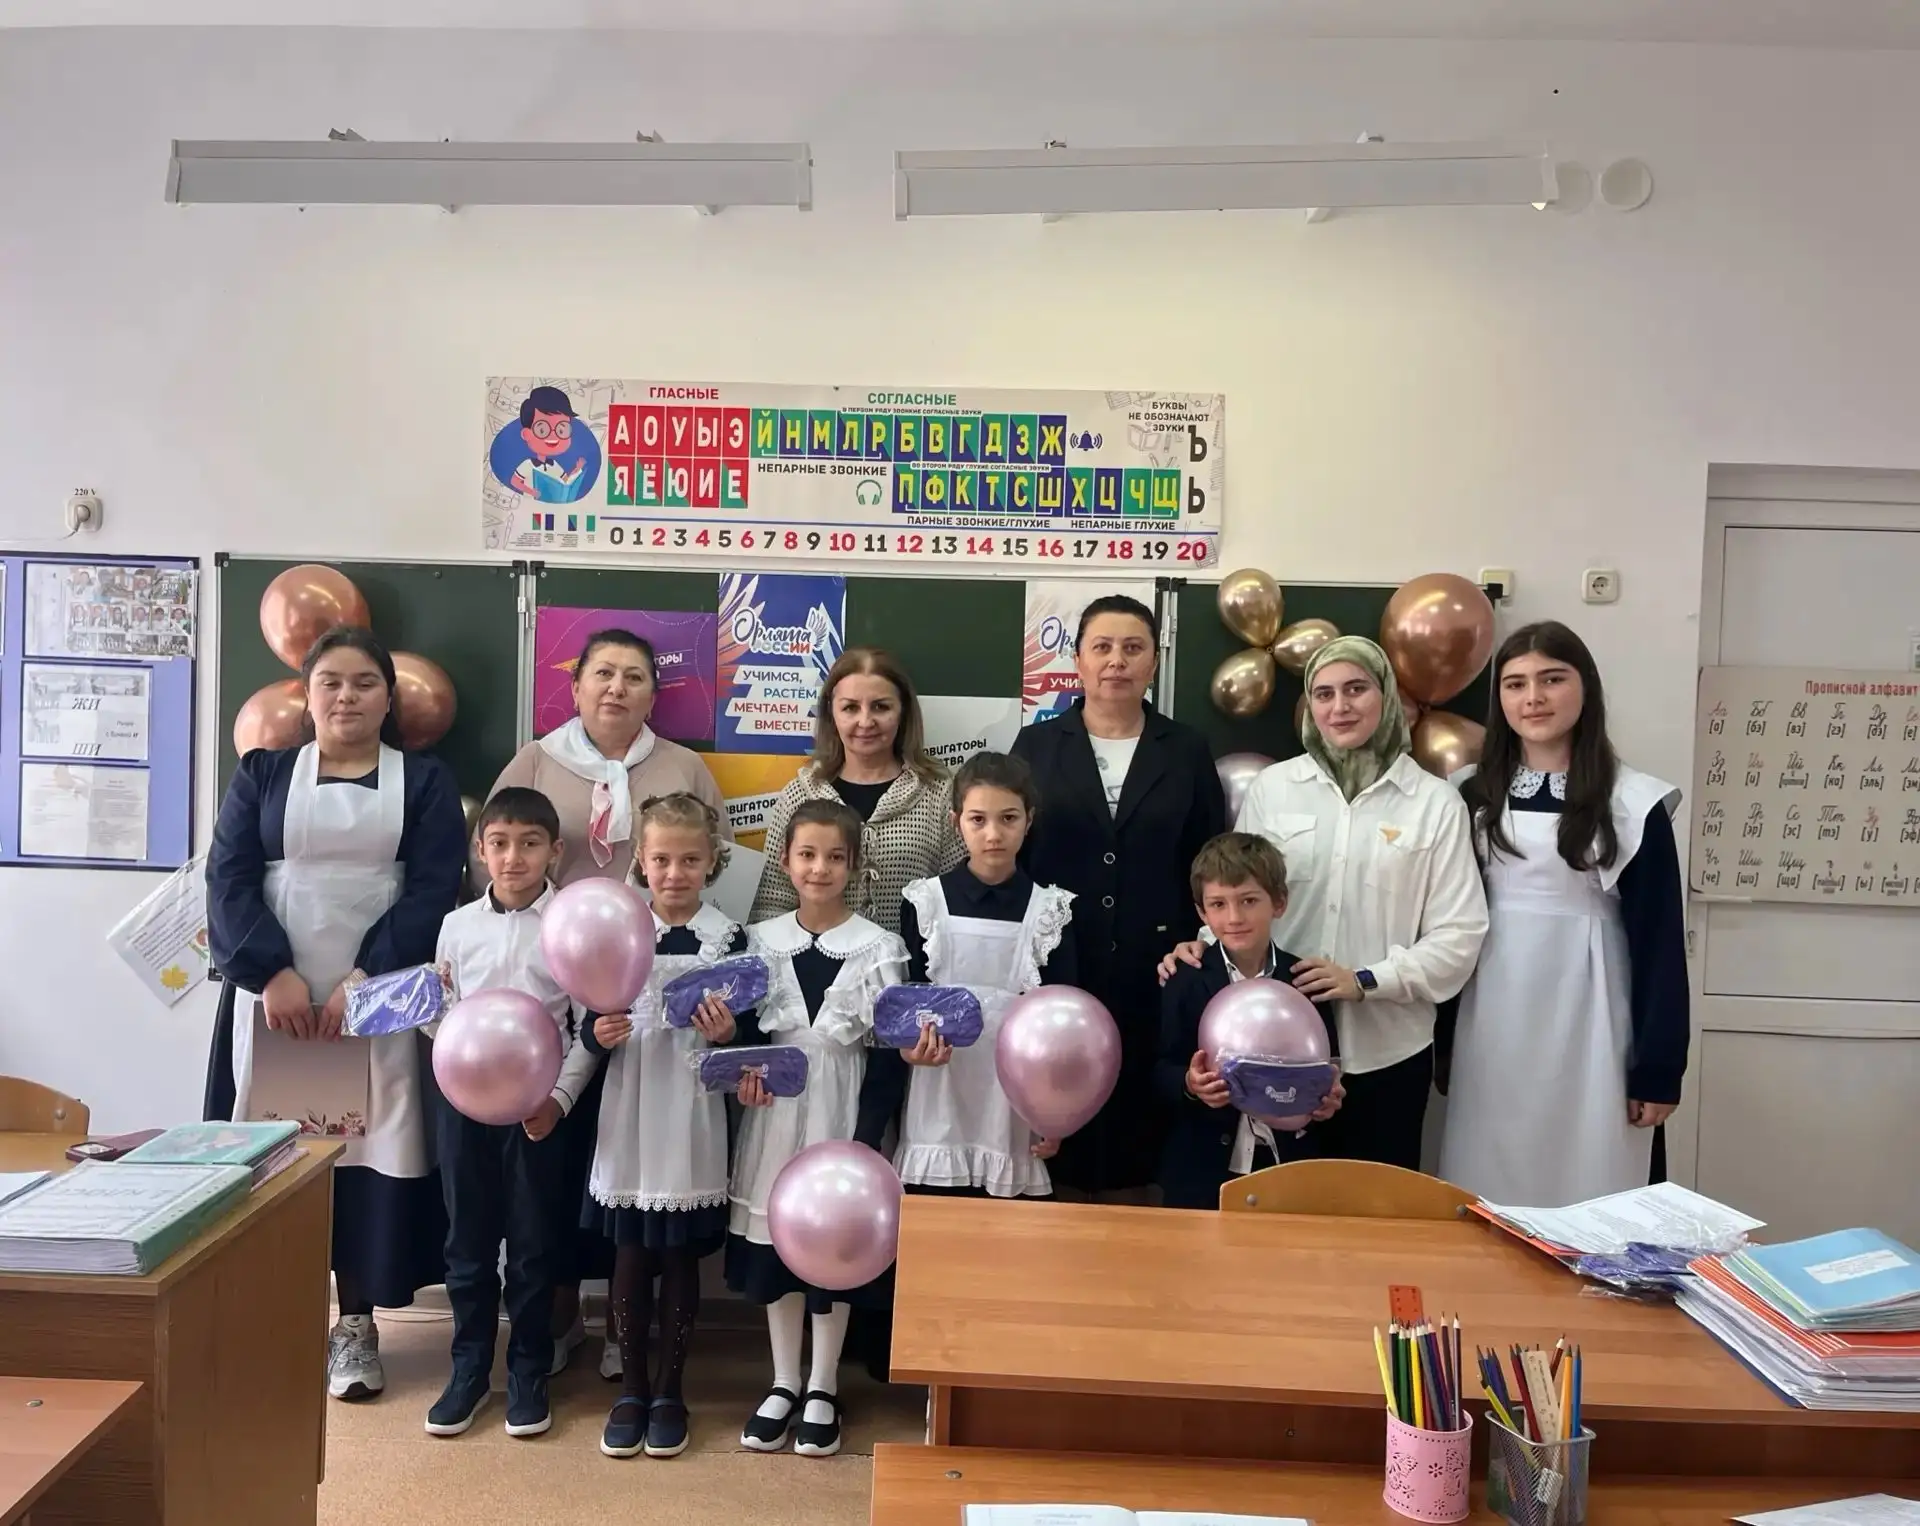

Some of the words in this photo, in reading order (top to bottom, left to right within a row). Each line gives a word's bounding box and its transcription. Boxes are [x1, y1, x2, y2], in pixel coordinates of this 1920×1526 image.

[649, 387, 719, 400] ГЛАСНЫЕ
[867, 392, 957, 405] СОГЛАСНЫЕ
[1152, 402, 1187, 410] БУКВЫ
[1128, 412, 1141, 420] НЕ
[1144, 412, 1209, 422] ОБОЗНАЧАЮТ
[614, 415, 630, 445] А
[644, 415, 658, 446] О
[671, 416, 687, 446] У
[697, 417, 718, 447] Ы
[729, 418, 743, 448] Э
[1153, 424, 1185, 432] ЗВУКИ
[1188, 425, 1207, 462] Ъ
[758, 463, 826, 474] НЕПАРНЫЕ
[830, 465, 887, 476] ЗВОНКИЕ
[614, 466, 629, 496] Я
[642, 464, 656, 499] Ё
[667, 467, 688, 498] Ю
[699, 468, 713, 499] И
[728, 469, 741, 499] Е
[74, 488, 88, 496] 220
[1188, 476, 1205, 514] Ь
[907, 516, 952, 526] ПАРНЫЕ
[956, 517, 1050, 528] ЗВОНКИЕ/ГЛУХИЕ
[1071, 520, 1131, 530] НЕПАРНЫЕ
[1134, 520, 1175, 530] ГЛУХИЕ
[610, 527, 624, 545] 0
[633, 528, 643, 545] 1
[652, 528, 666, 546] 2
[673, 529, 687, 546] 3
[695, 529, 710, 547] 4
[718, 530, 732, 547] 5
[741, 531, 754, 548] 6
[764, 531, 776, 549] 7
[784, 531, 798, 549] 8
[807, 532, 820, 550] 9
[830, 533, 855, 551] 10
[864, 534, 887, 552] 11
[897, 535, 923, 553] 12
[932, 536, 957, 554] 13
[967, 537, 993, 555] 14
[1002, 538, 1028, 556] 15
[1038, 539, 1064, 557] 16
[1073, 540, 1098, 558] 17
[1107, 540, 1133, 559] 18
[1142, 541, 1169, 560] 19
[1177, 542, 1207, 560] 20
[735, 608, 811, 646] Орлята
[743, 670, 802, 683] УЧИМСЯ,
[1805, 680, 1866, 696] Прописной
[1870, 682, 1918, 698] алфавит
[72, 697, 101, 710] ЖИ
[734, 703, 798, 714] МЕЧТАЕМ
[754, 720, 811, 731] ВМЕСТЕ!
[72, 743, 101, 756] ШИ
[726, 798, 778, 814] ВИГАТОР
[730, 813, 763, 827] ТСТВА
